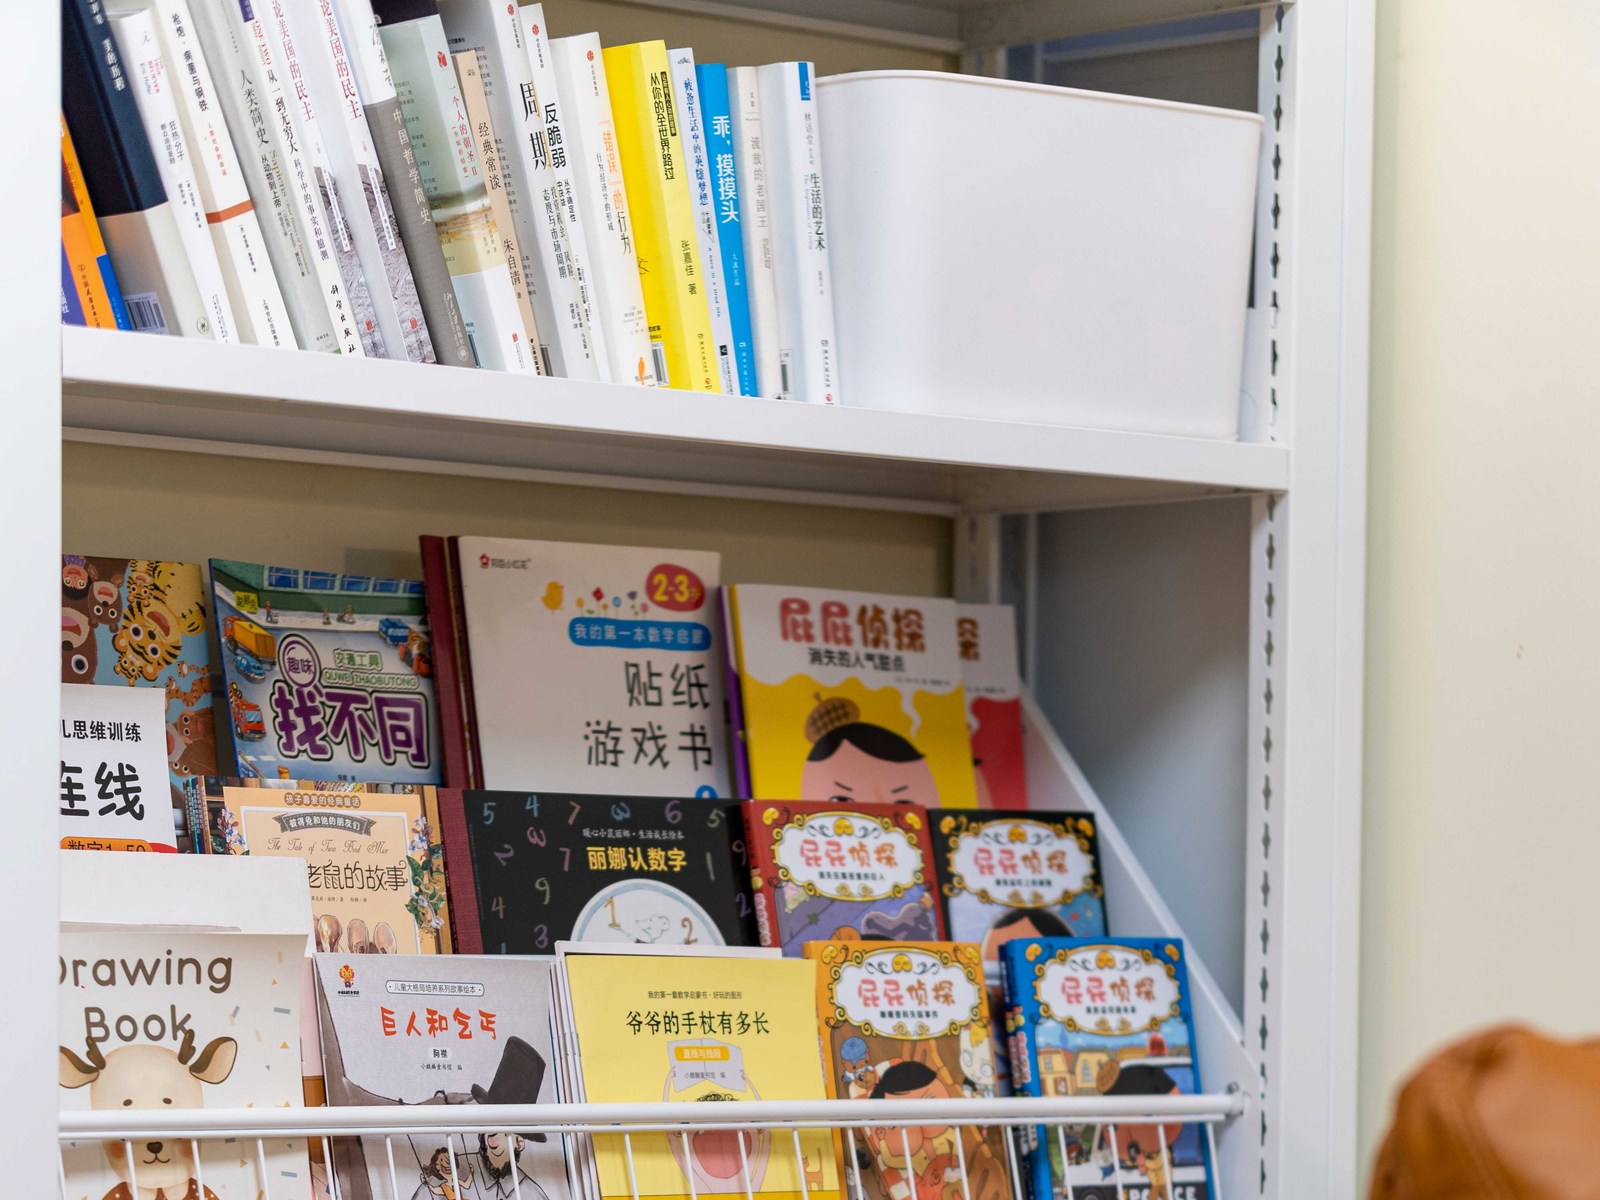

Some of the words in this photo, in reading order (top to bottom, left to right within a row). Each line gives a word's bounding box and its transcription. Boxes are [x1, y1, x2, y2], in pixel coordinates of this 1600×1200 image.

[102, 38, 126, 92] 美的历程
[271, 0, 315, 122] 论美国的民主
[319, 0, 362, 122] 论美国的民主
[241, 69, 270, 148] 人类简史
[267, 69, 298, 156] 从一到无穷大
[520, 79, 553, 171] 周期
[650, 72, 676, 181] 从你的全世界路过
[169, 120, 184, 162] 狂热分子
[544, 102, 567, 169] 反脆弱
[683, 77, 709, 206] 疲惫生活中的英雄梦想
[393, 107, 432, 226] 中国哲学简史
[478, 122, 501, 190] 经典常谈
[712, 115, 740, 224] 乖，摸摸头
[261, 154, 283, 210] 从动物到上帝
[750, 136, 768, 229] 流放的老国王
[293, 158, 329, 262] 科学中的事实和臆测
[809, 172, 827, 252] 生活的艺术
[542, 188, 568, 279] 态度与市场周期
[503, 238, 522, 286] 朱自清
[680, 239, 694, 277] 张嘉佳
[778, 597, 927, 654] 屁屁侦探
[286, 656, 315, 675] 趣味
[336, 651, 380, 667] 交通工具
[353, 673, 417, 687] ZHAOBUTONG
[624, 660, 710, 711] 贴纸
[273, 685, 428, 764] 找不同
[583, 720, 714, 771] 游戏书
[285, 792, 361, 808] 孩子喜爱的经典童话
[482, 802, 497, 825] 5
[525, 794, 541, 818] 4
[567, 800, 582, 825] 7
[664, 800, 683, 824] 6
[707, 808, 726, 828] 5
[289, 815, 361, 831] 彼得兔和他的朋友们
[267, 837, 281, 851] The
[559, 847, 571, 872] 7
[586, 846, 688, 873] 丽娜认数字
[800, 838, 898, 869] 屁屁侦探
[973, 847, 1068, 876] 屁屁侦探
[307, 859, 409, 892] 老鼠的故事
[535, 877, 550, 905] 9
[491, 896, 506, 920] 4
[533, 923, 549, 949] 3
[59, 949, 233, 994] rawing
[393, 982, 477, 994] 儿童大格局培养系列故事绘本
[1061, 975, 1156, 1005] 屁屁侦探
[857, 978, 956, 1008] 屁屁侦探
[84, 1004, 192, 1043] Book
[380, 1005, 497, 1041] 巨人和乞丐
[625, 1010, 770, 1036] 爷爷的手杖有多长
